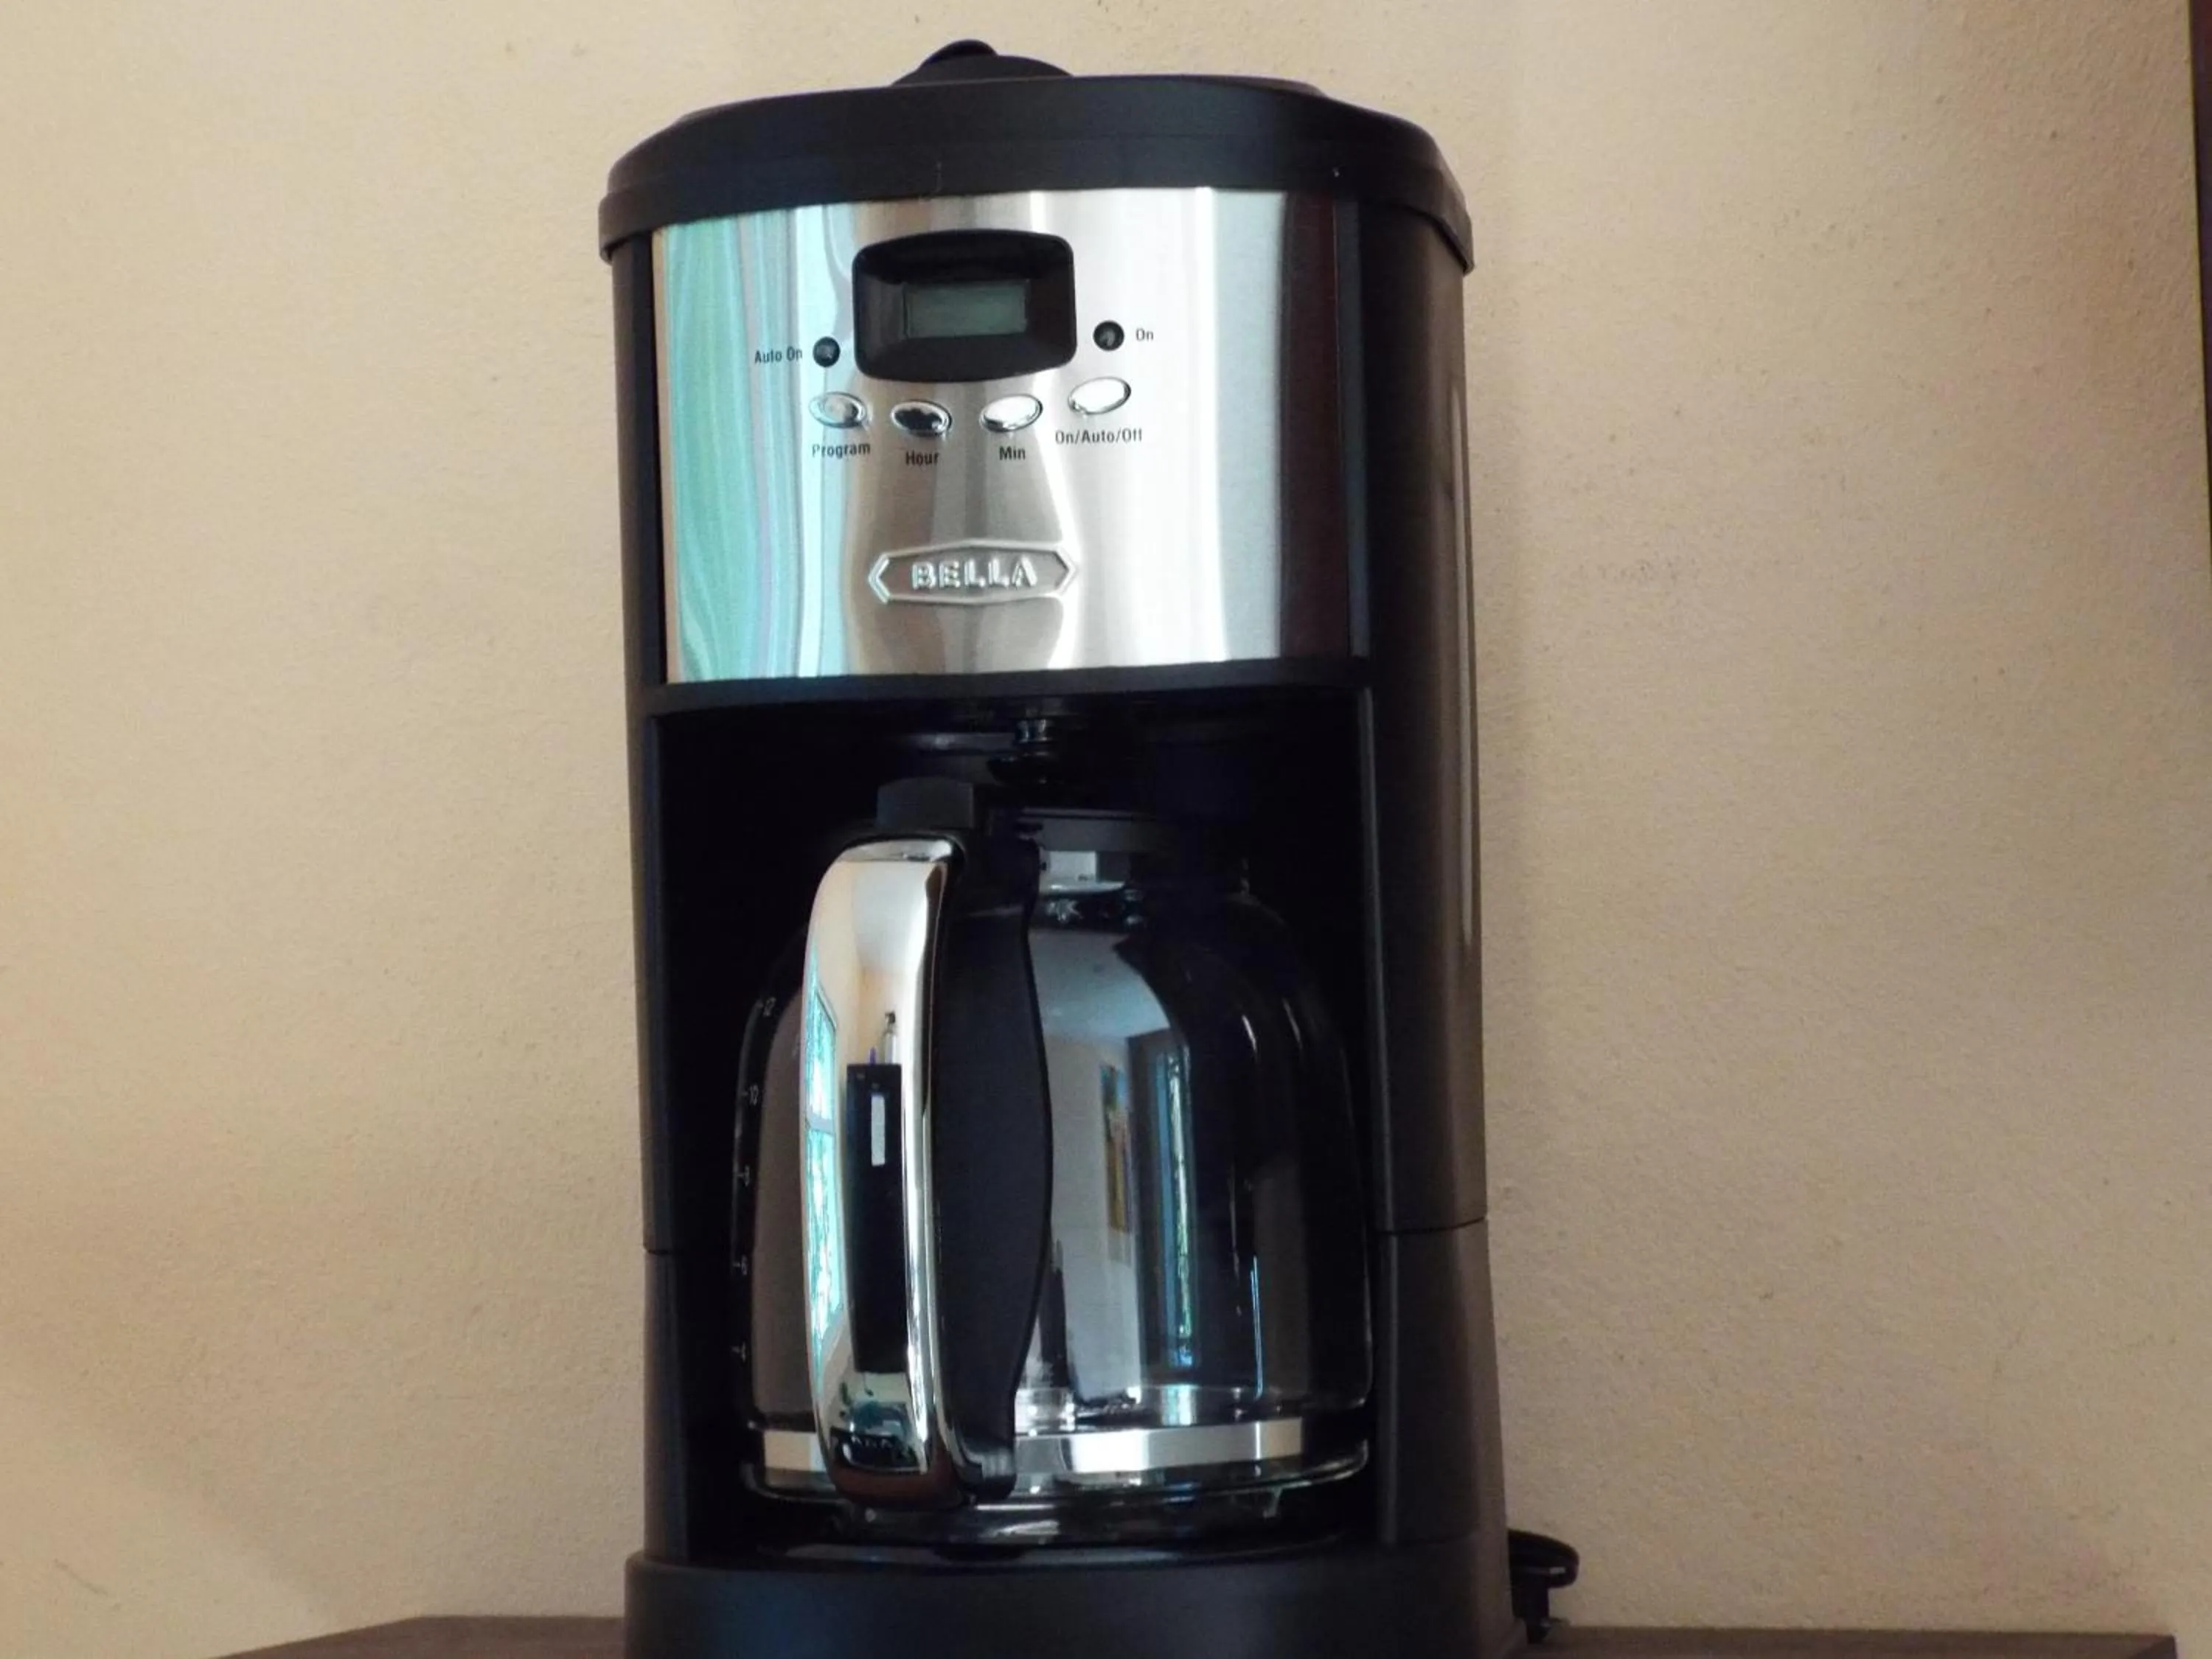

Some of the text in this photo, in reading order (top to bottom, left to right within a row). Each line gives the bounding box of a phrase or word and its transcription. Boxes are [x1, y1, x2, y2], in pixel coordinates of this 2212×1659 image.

[1135, 327, 1154, 341] On
[754, 345, 803, 364] Auto On
[812, 442, 871, 459] Program
[905, 450, 939, 466] Hour
[999, 445, 1026, 461] Min
[911, 554, 1037, 589] BELLA
